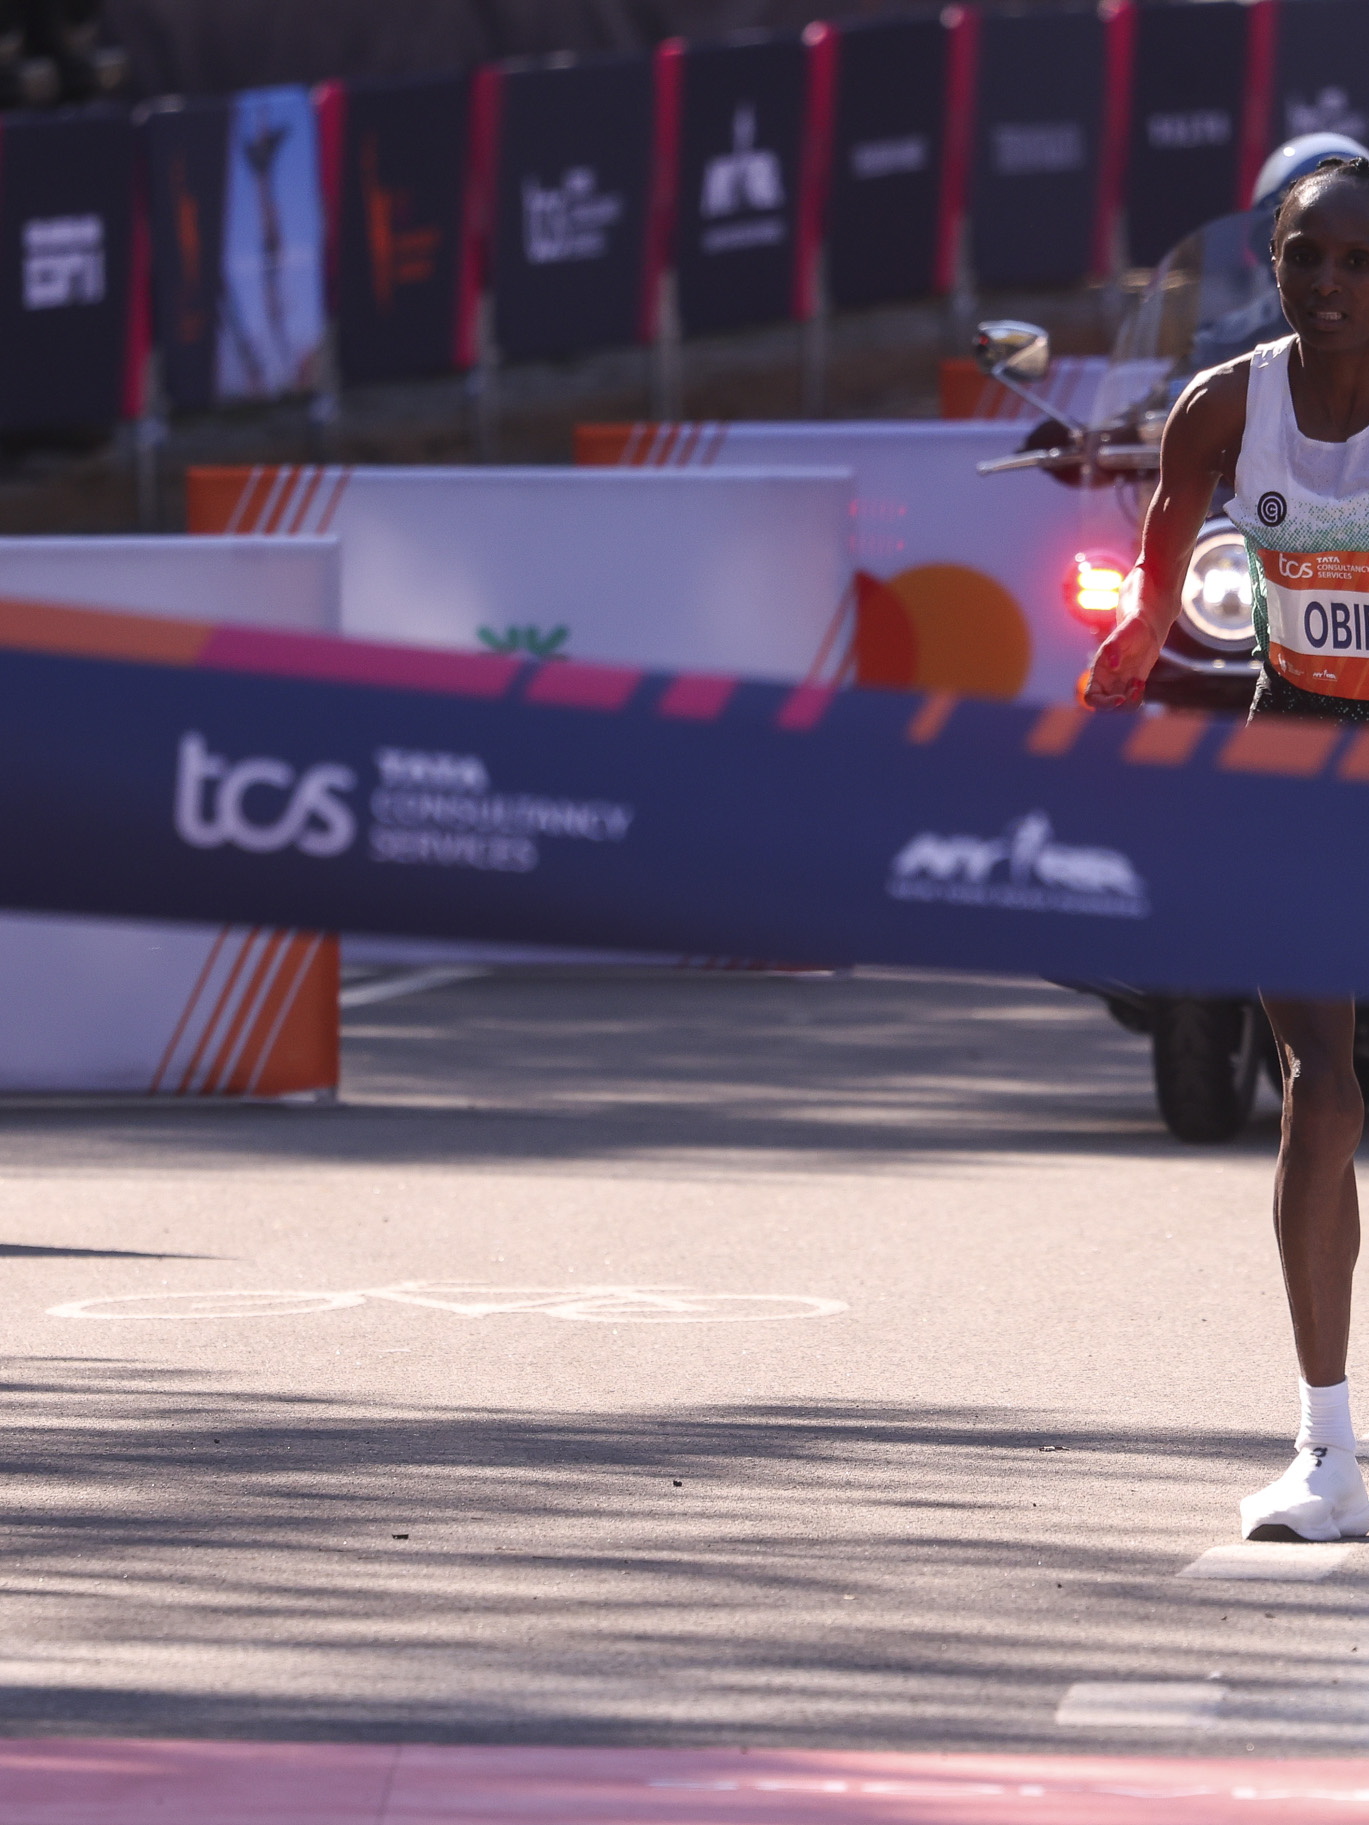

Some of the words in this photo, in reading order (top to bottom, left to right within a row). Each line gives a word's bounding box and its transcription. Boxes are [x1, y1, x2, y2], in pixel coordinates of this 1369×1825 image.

[1278, 553, 1314, 579] tcs
[1316, 556, 1340, 564] TATA
[1317, 571, 1353, 580] SERVICES
[376, 747, 488, 792] TATA
[173, 730, 358, 858] tcs
[371, 787, 635, 842] CONSULTANCY
